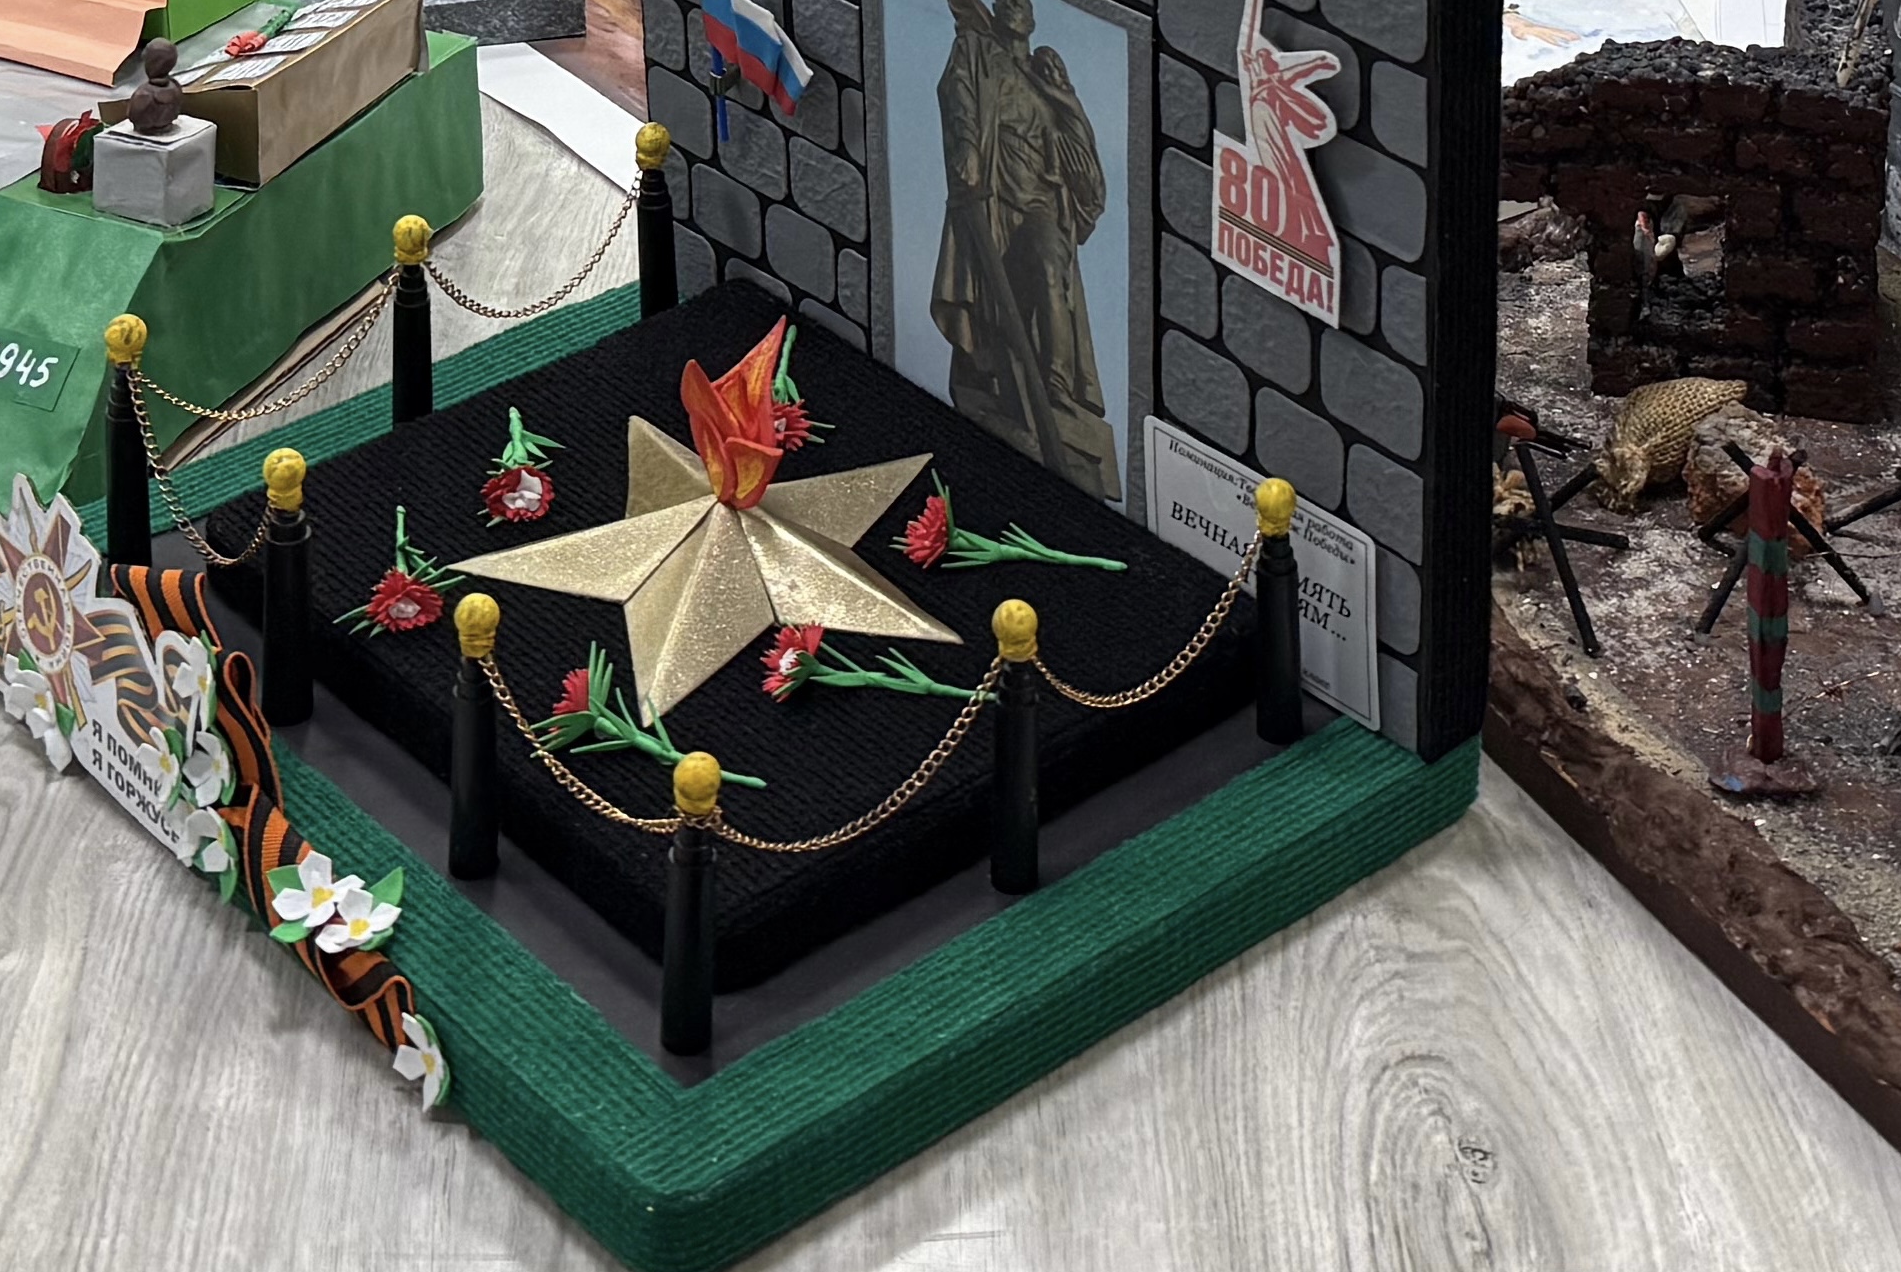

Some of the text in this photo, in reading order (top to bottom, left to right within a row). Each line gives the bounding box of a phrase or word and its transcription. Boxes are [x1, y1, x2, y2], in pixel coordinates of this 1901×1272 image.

[1219, 147, 1280, 237] 80
[1217, 221, 1335, 316] ПОБЕДА!
[92, 718, 103, 743] Я
[92, 748, 103, 772] Я
